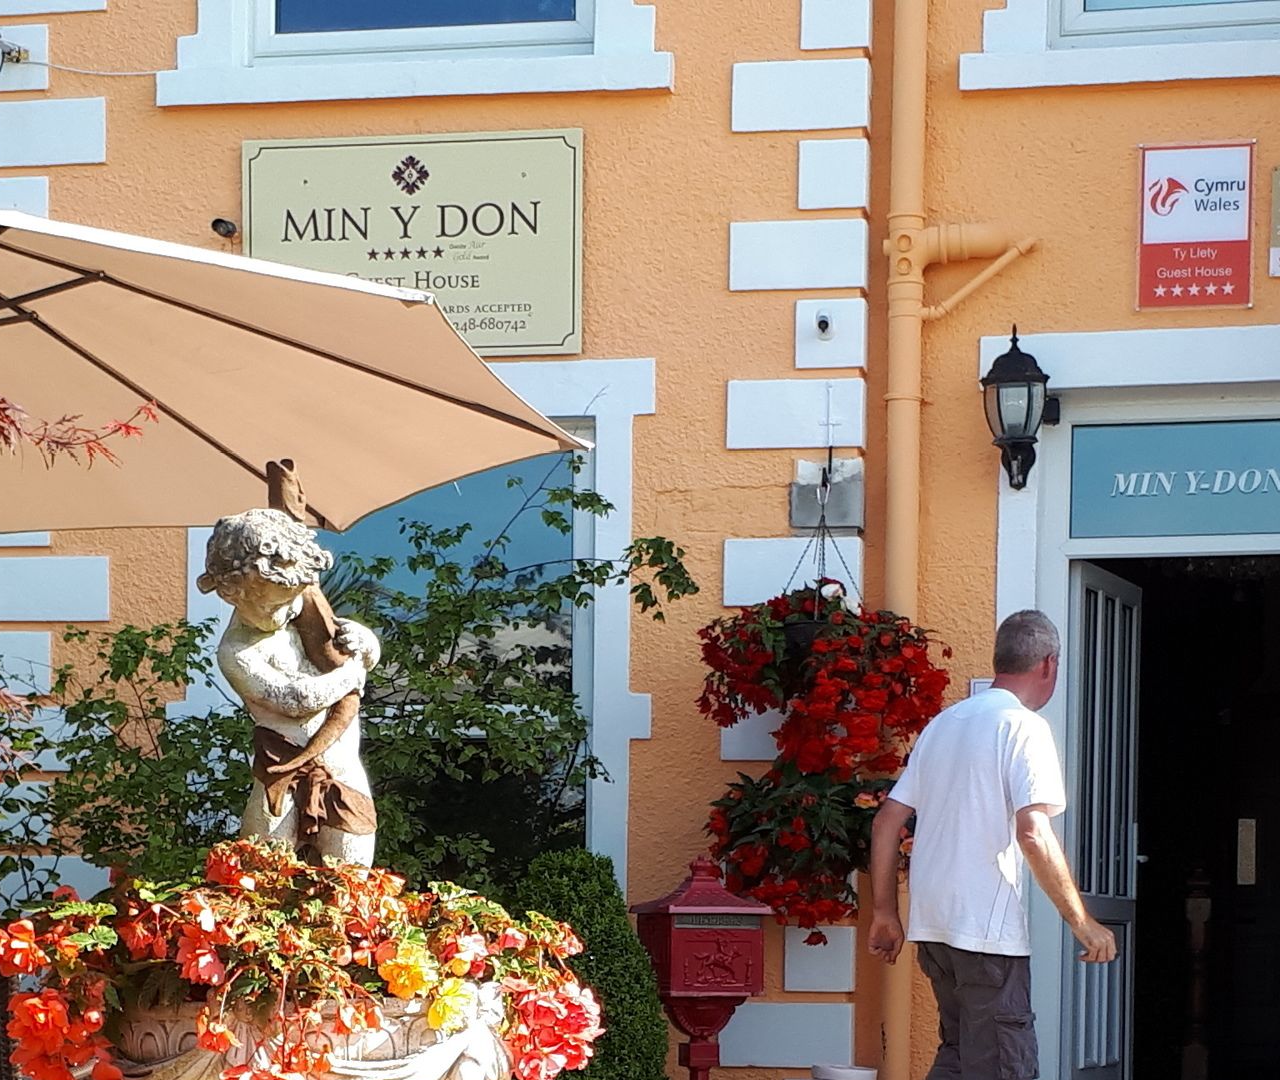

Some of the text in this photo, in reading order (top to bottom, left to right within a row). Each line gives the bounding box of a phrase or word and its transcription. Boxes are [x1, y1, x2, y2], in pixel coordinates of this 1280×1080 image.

[1193, 178, 1247, 197] Cymru
[1194, 197, 1240, 212] Wales
[281, 201, 541, 242] MIN Y DON
[1172, 247, 1187, 261] Ty
[346, 272, 406, 288] EST
[1156, 266, 1233, 279] Guest House
[442, 303, 532, 314] ARDS ACCEPTED
[1110, 471, 1177, 497] MIN
